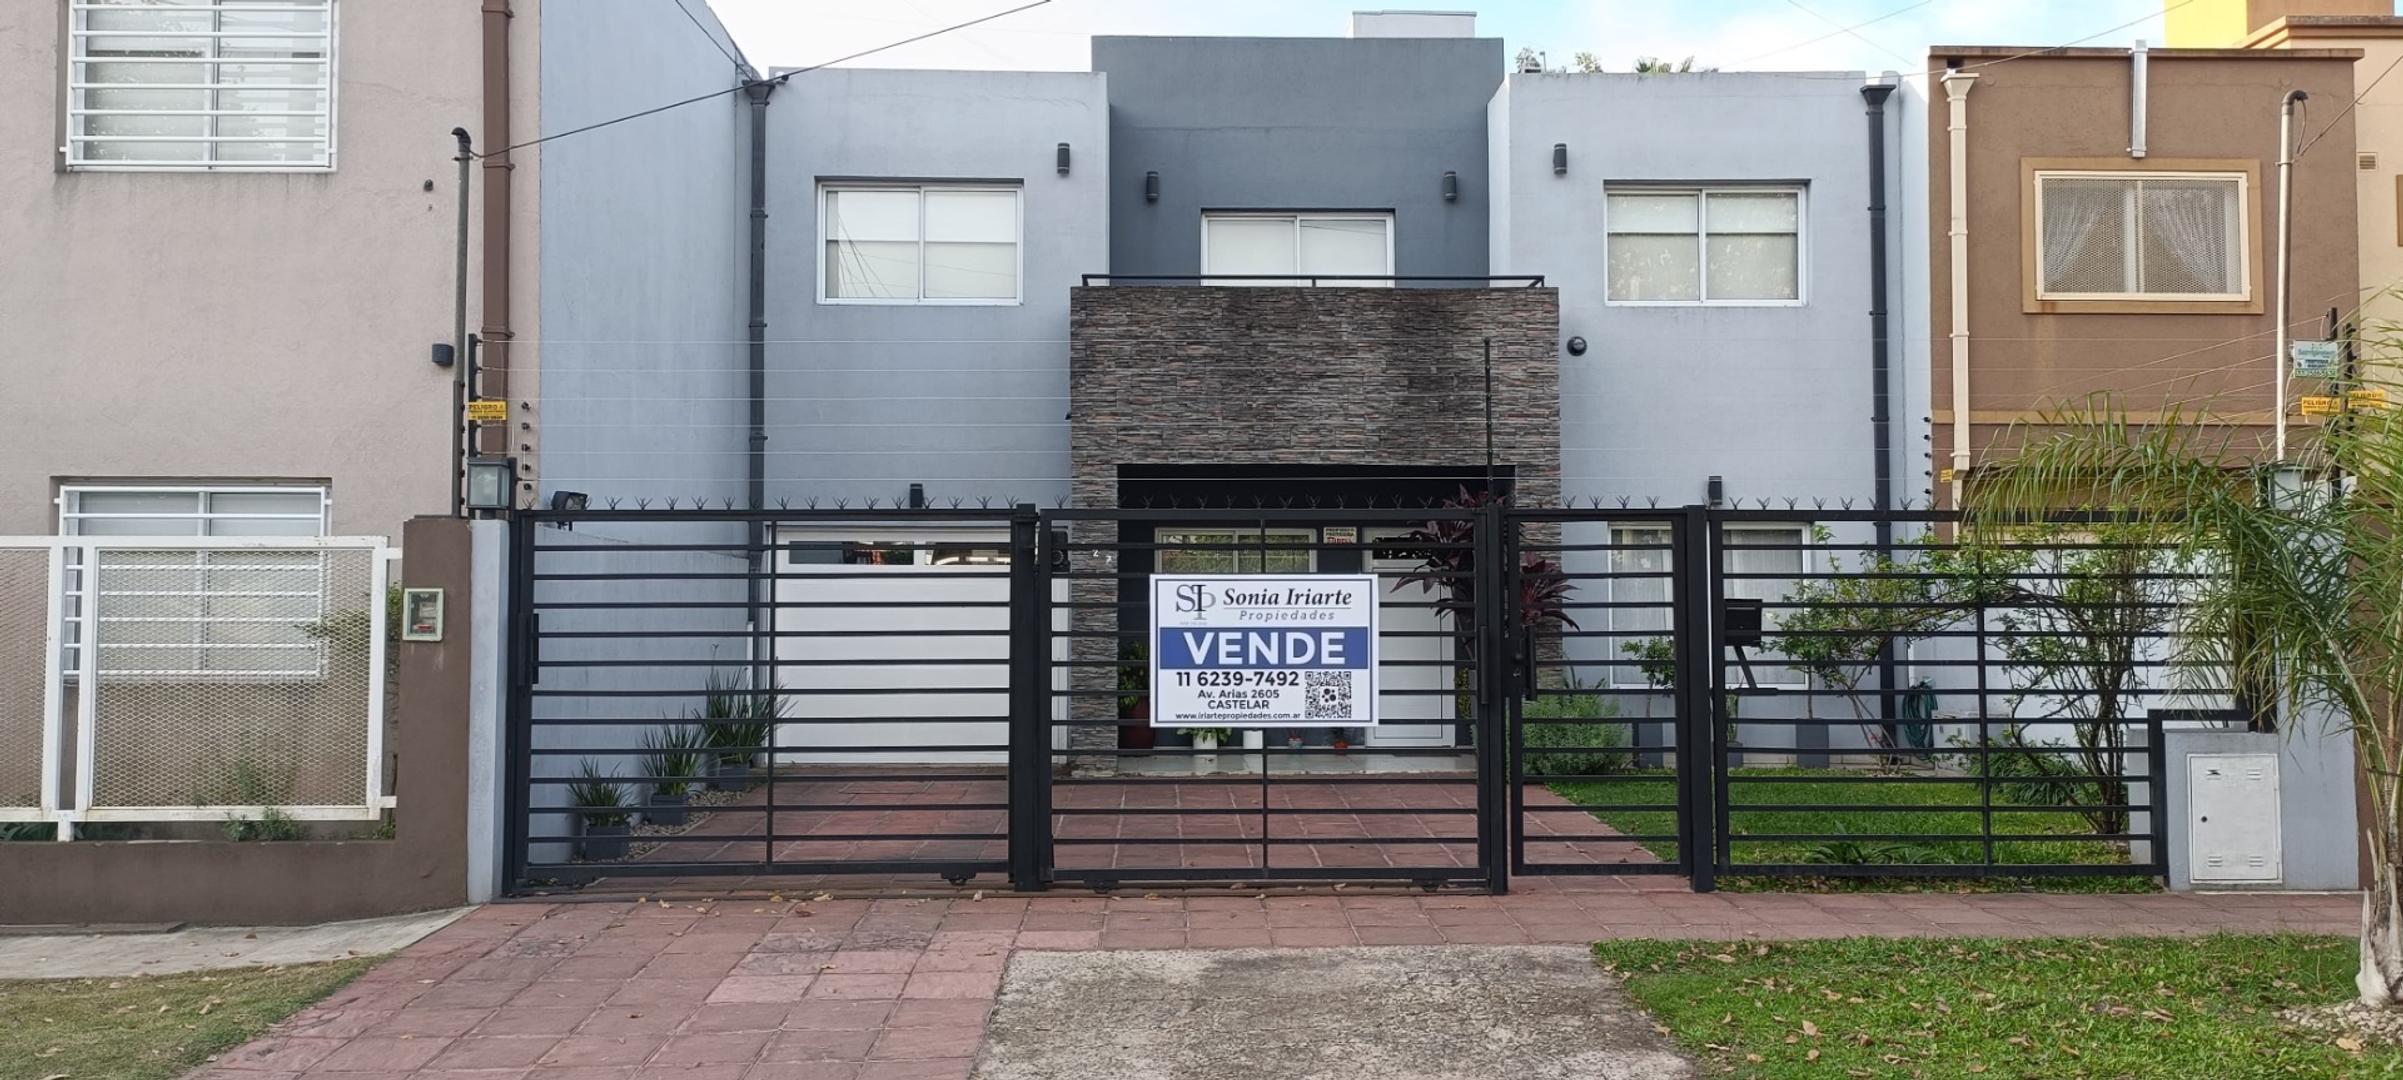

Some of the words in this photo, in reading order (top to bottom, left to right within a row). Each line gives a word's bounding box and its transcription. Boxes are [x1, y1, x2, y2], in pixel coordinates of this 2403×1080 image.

[1223, 588, 1279, 606] Sonia
[1286, 587, 1352, 606] Iriarte
[1239, 610, 1335, 623] Propiedades
[1183, 631, 1346, 666] VENDE
[1176, 671, 1191, 687] 11
[1197, 671, 1300, 687] 6239-7492
[1197, 689, 1216, 699] Av.
[1218, 689, 1248, 699] Arias
[1250, 689, 1280, 699] 2605
[1207, 700, 1270, 710] CASTELAR
[1175, 711, 1302, 720] www.iriartepropiedades.com.ar
